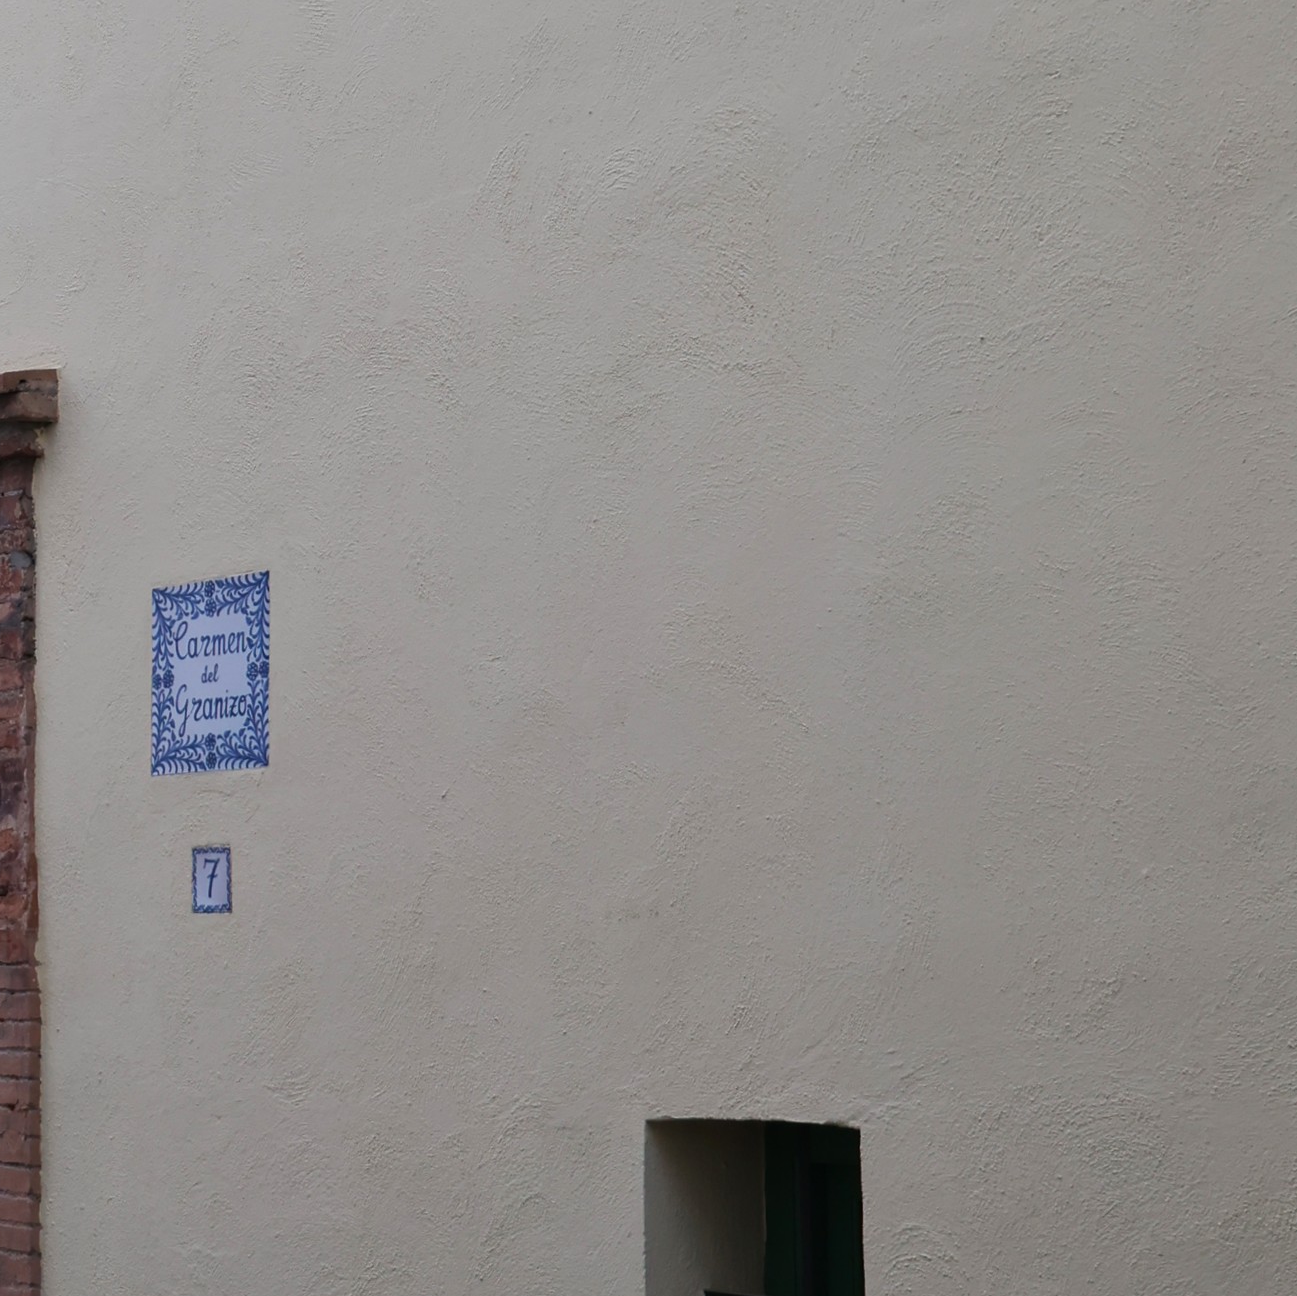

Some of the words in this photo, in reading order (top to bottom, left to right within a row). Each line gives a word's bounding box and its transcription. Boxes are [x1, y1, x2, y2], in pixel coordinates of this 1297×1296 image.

[173, 621, 248, 660] Carmen
[201, 663, 219, 684] del
[175, 684, 248, 738] Granizo
[203, 857, 220, 899] 7
